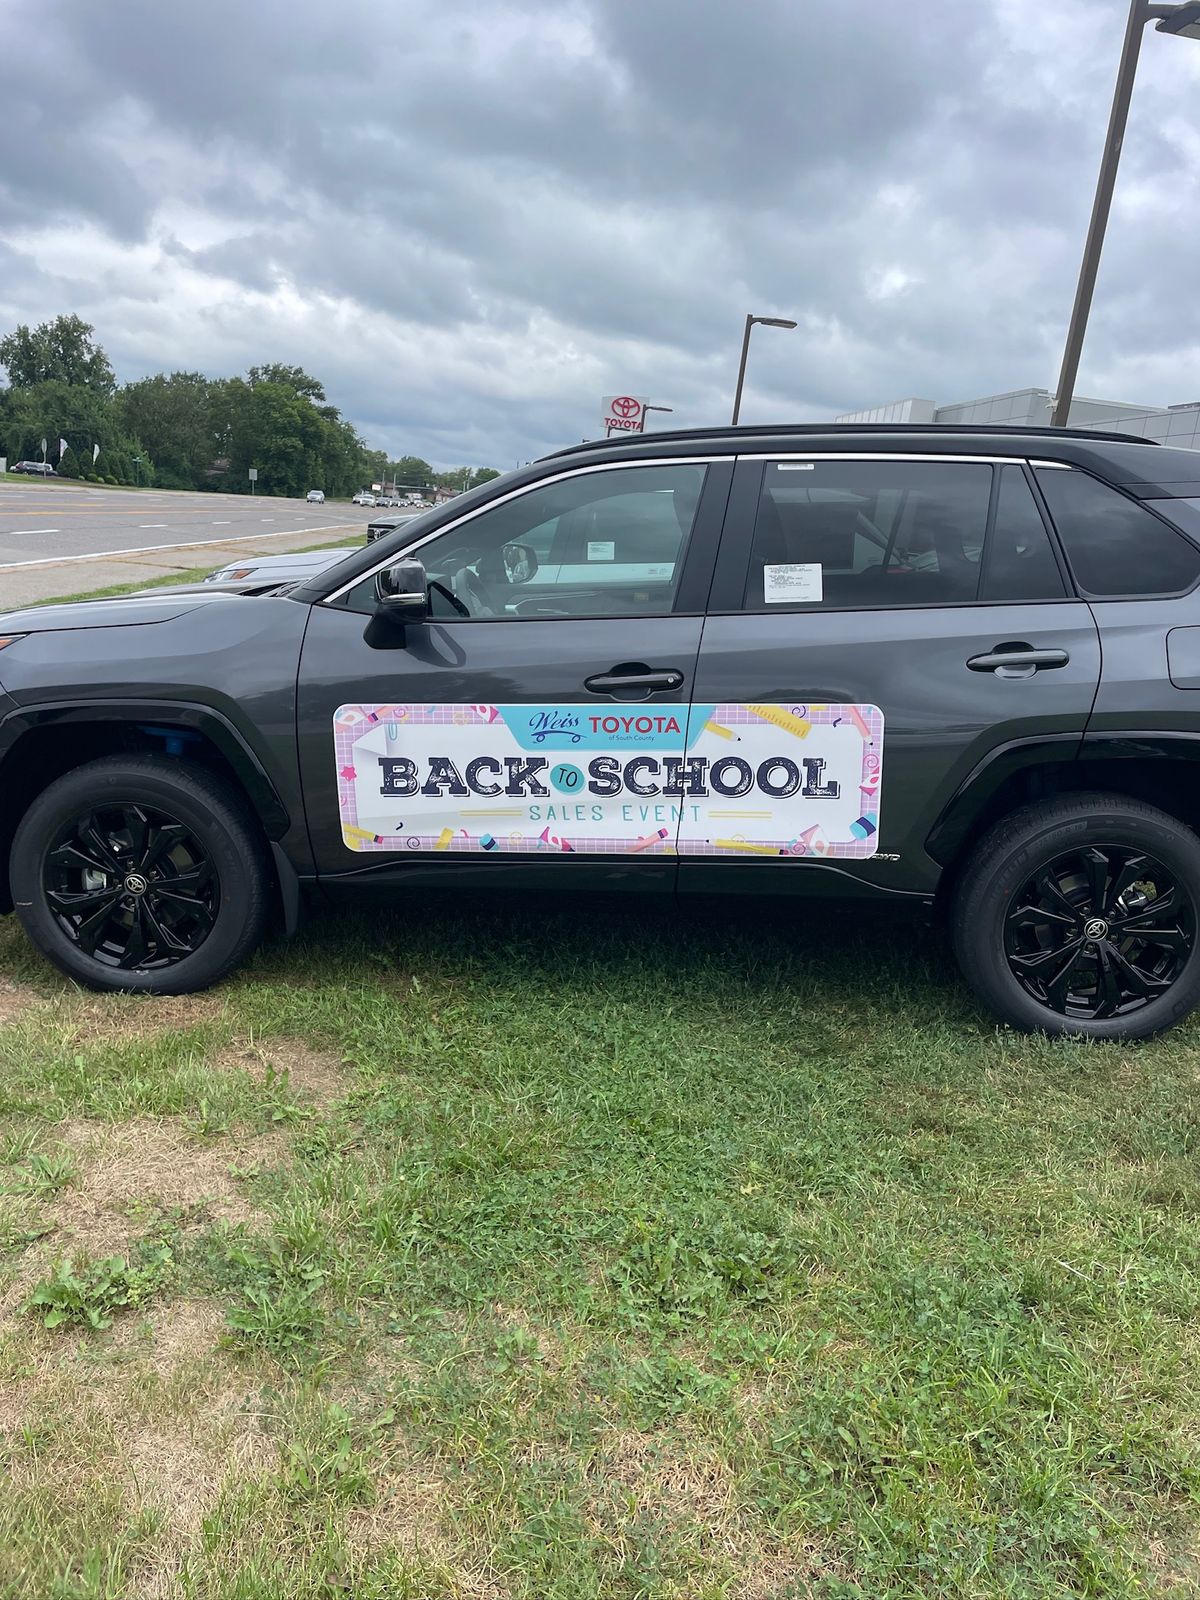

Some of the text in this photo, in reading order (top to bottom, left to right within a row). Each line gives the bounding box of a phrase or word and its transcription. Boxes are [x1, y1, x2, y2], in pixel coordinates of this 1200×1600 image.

[529, 711, 681, 734] Weiss TOYOTA
[378, 756, 840, 799] BACK TO SCHOOL
[529, 805, 701, 822] SALES EVENT
